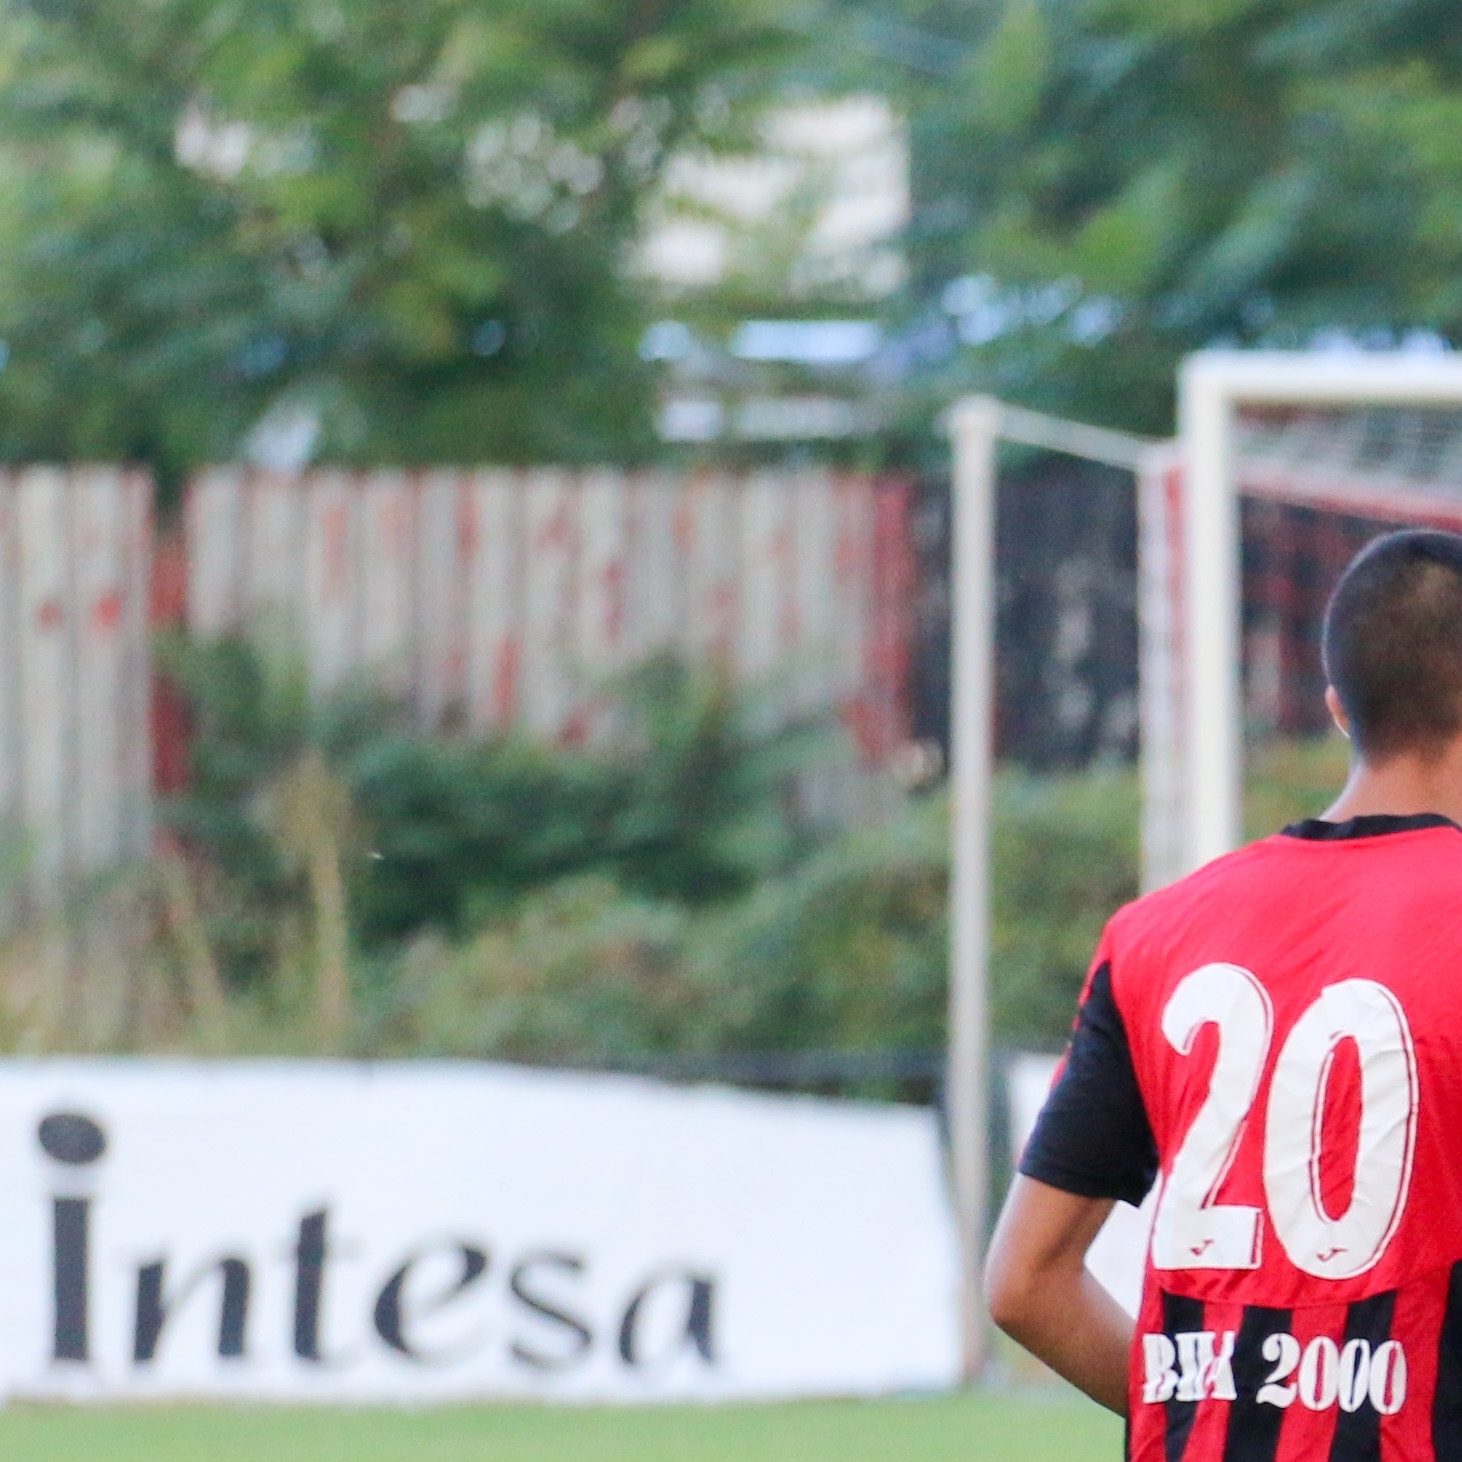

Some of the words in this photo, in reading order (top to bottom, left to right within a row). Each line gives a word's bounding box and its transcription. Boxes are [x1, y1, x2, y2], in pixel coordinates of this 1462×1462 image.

[36, 1112, 722, 1370] intesa
[1150, 962, 1420, 1282] 20
[1255, 1332, 1407, 1415] 2000
